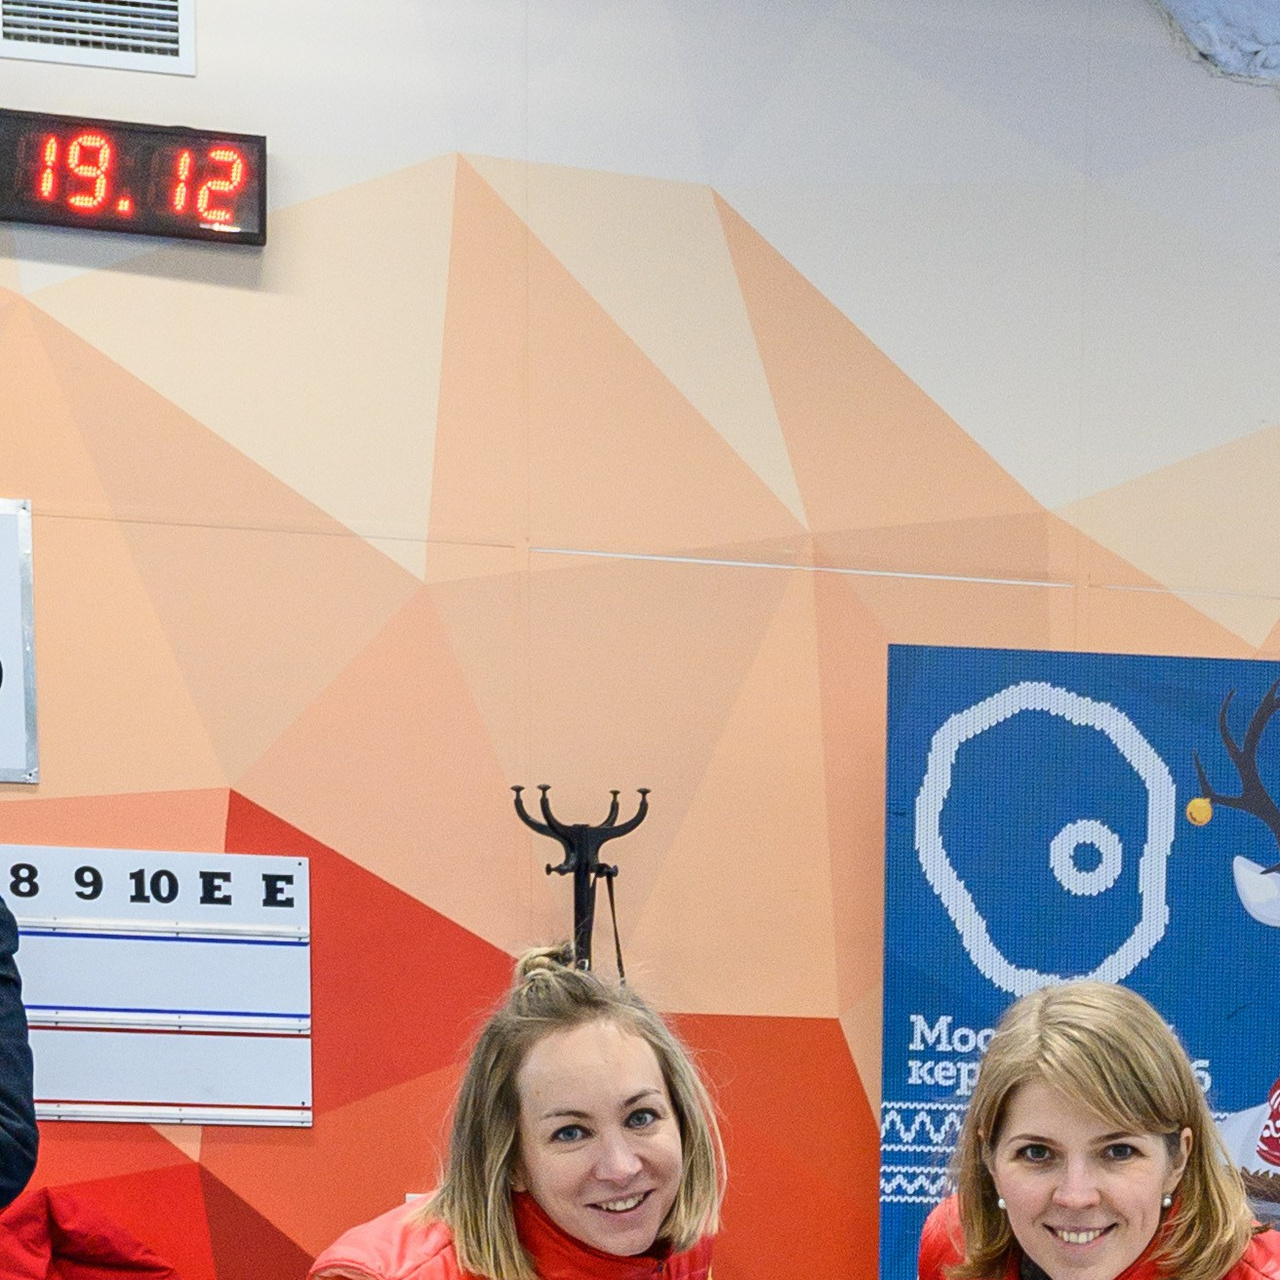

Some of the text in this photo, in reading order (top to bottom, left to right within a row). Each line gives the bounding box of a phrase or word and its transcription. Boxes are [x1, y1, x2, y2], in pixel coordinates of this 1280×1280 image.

[9, 863, 295, 908] 8 9 10 E E
